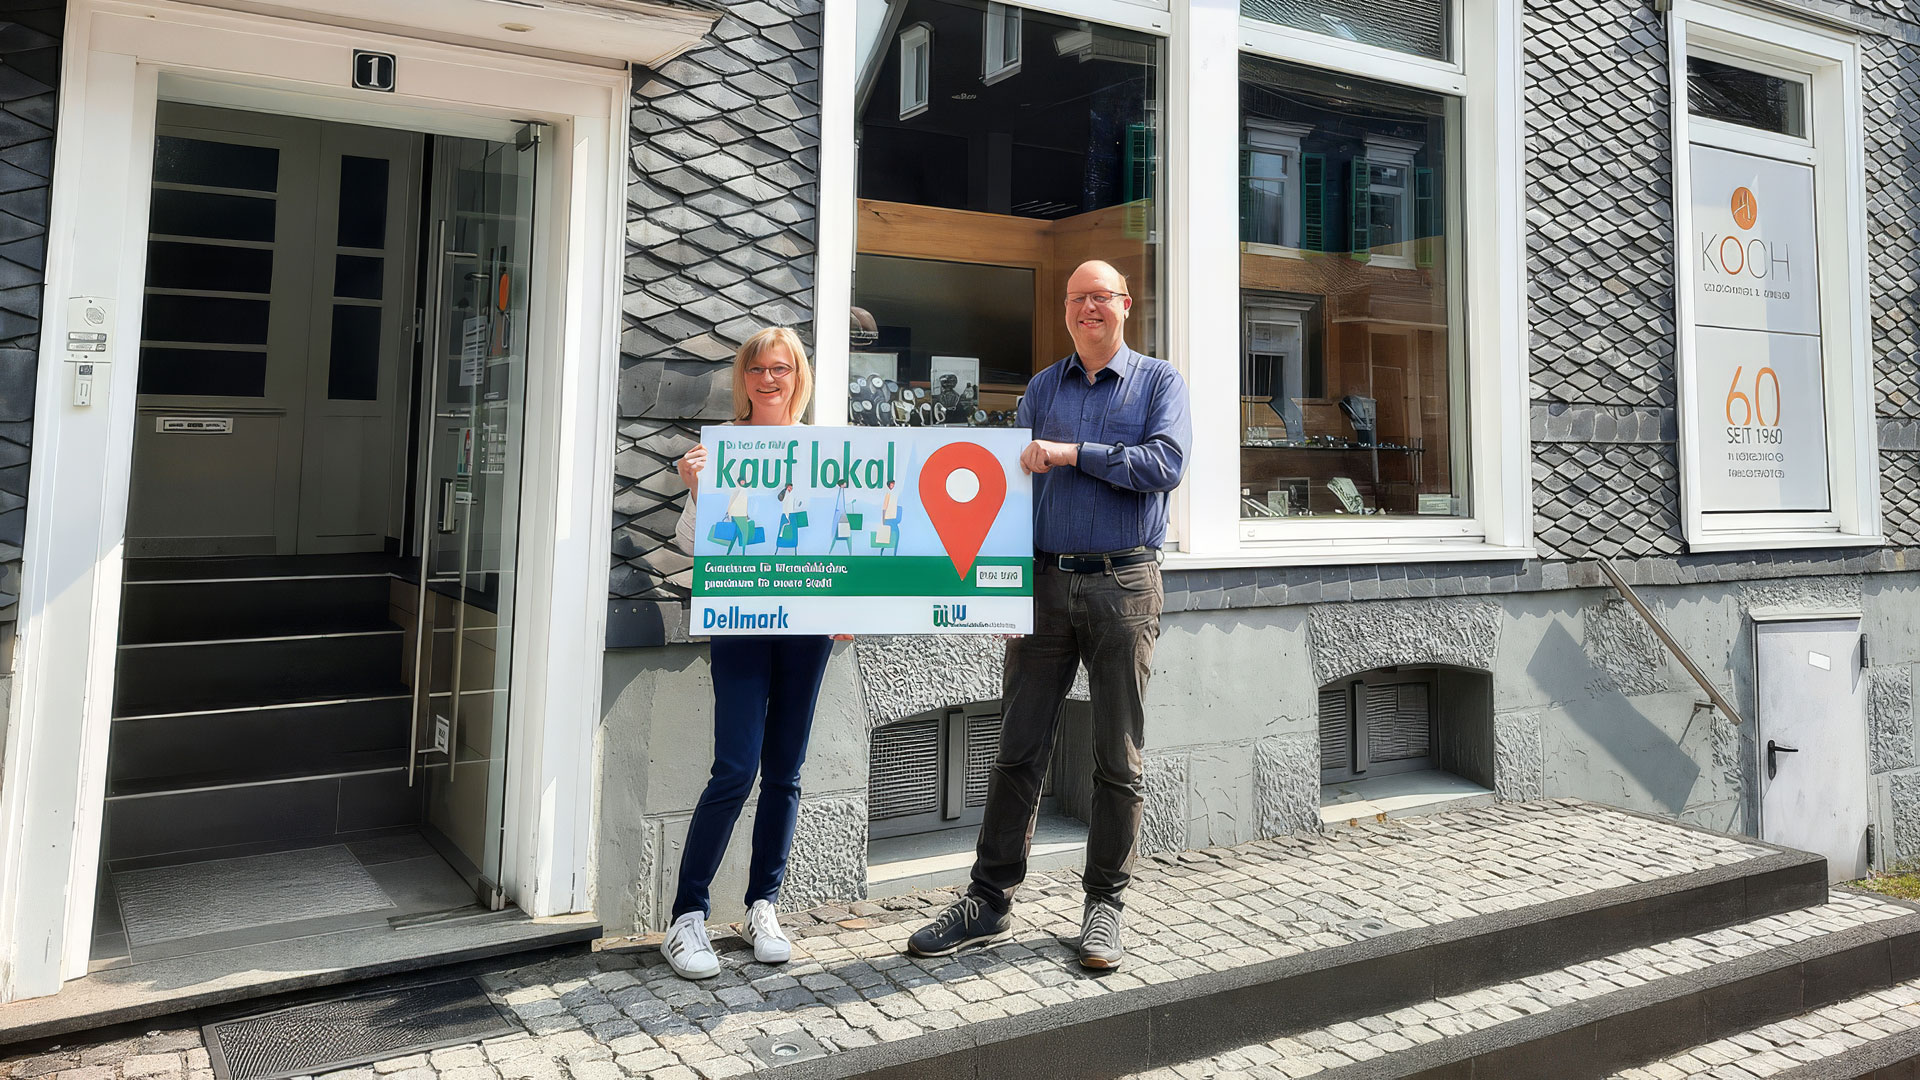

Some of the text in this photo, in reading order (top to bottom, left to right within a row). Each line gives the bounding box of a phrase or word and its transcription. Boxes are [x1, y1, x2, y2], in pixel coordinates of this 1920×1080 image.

[367, 57, 379, 87] 1
[1701, 231, 1790, 282] KOCH
[1725, 365, 1780, 427] 60
[1726, 426, 1783, 445] SEIT 1960
[716, 440, 895, 488] kauf lokal
[703, 605, 789, 629] Dellmark
